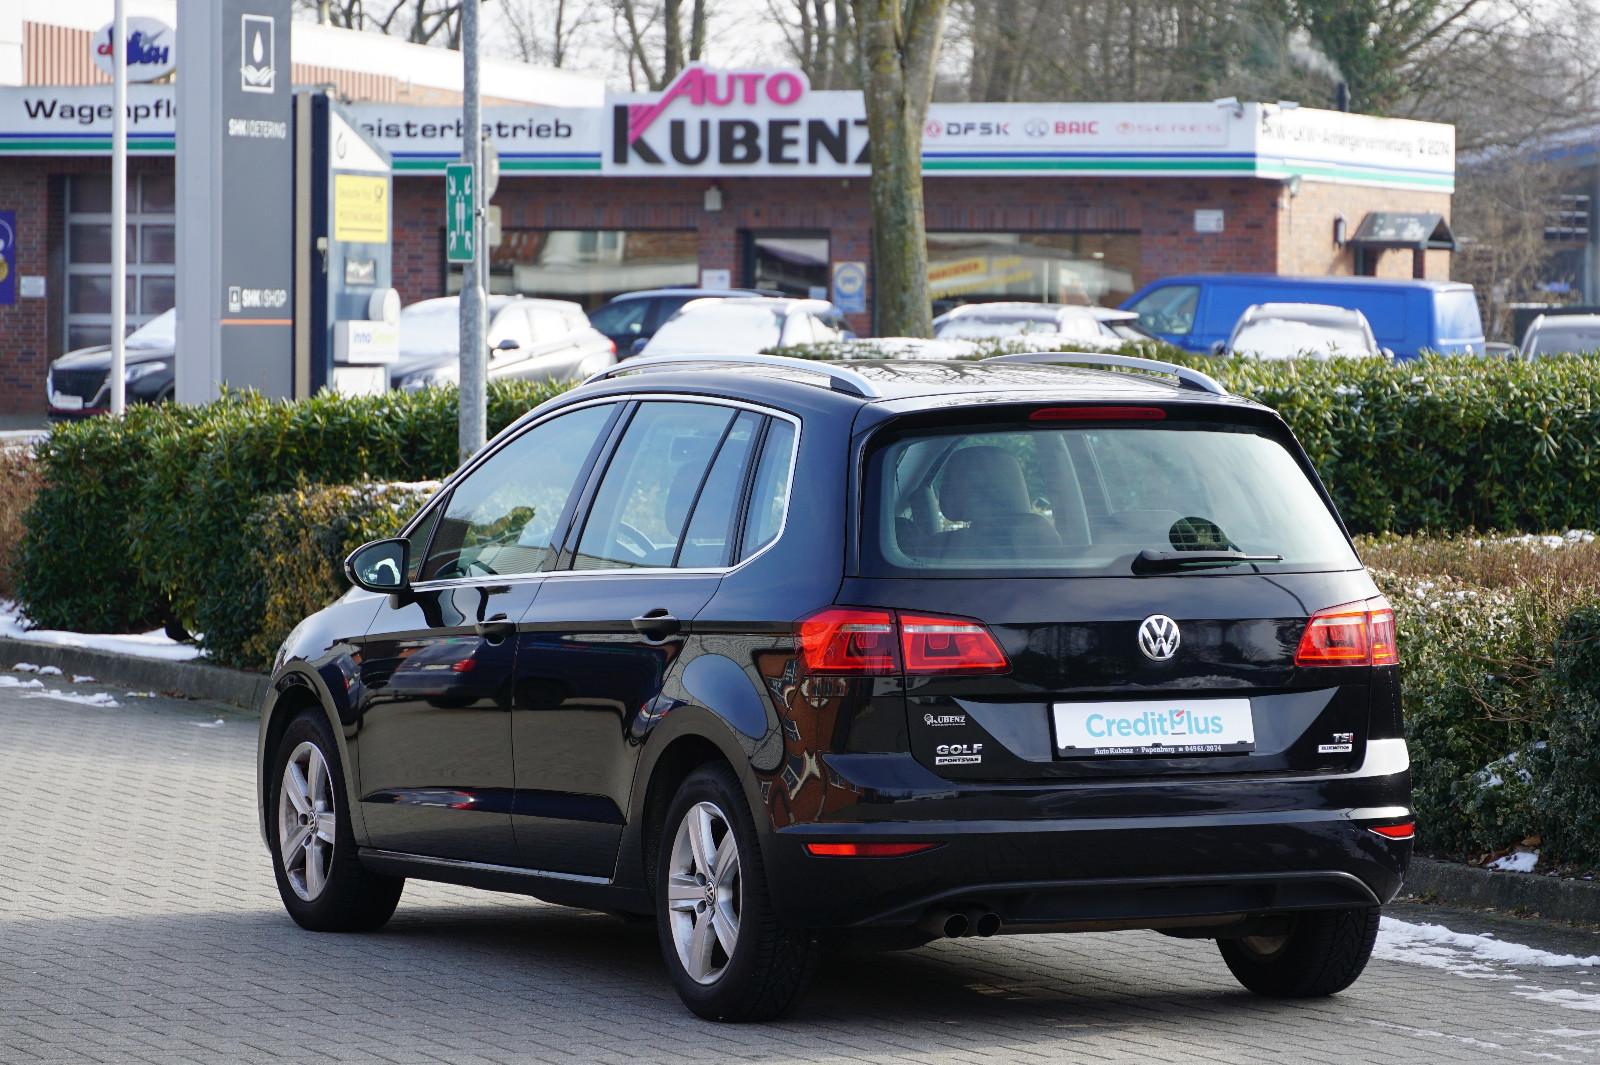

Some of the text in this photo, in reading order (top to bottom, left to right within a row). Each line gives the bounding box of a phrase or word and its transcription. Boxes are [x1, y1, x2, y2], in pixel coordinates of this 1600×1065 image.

[668, 67, 804, 106] AUTO
[24, 99, 176, 125] Wagepfl
[946, 121, 1009, 136] DFSK
[1054, 121, 1098, 135] BAIC
[1332, 732, 1354, 743] TSI
[936, 744, 982, 754] GOLF
[1141, 746, 1175, 755] Papenburg
